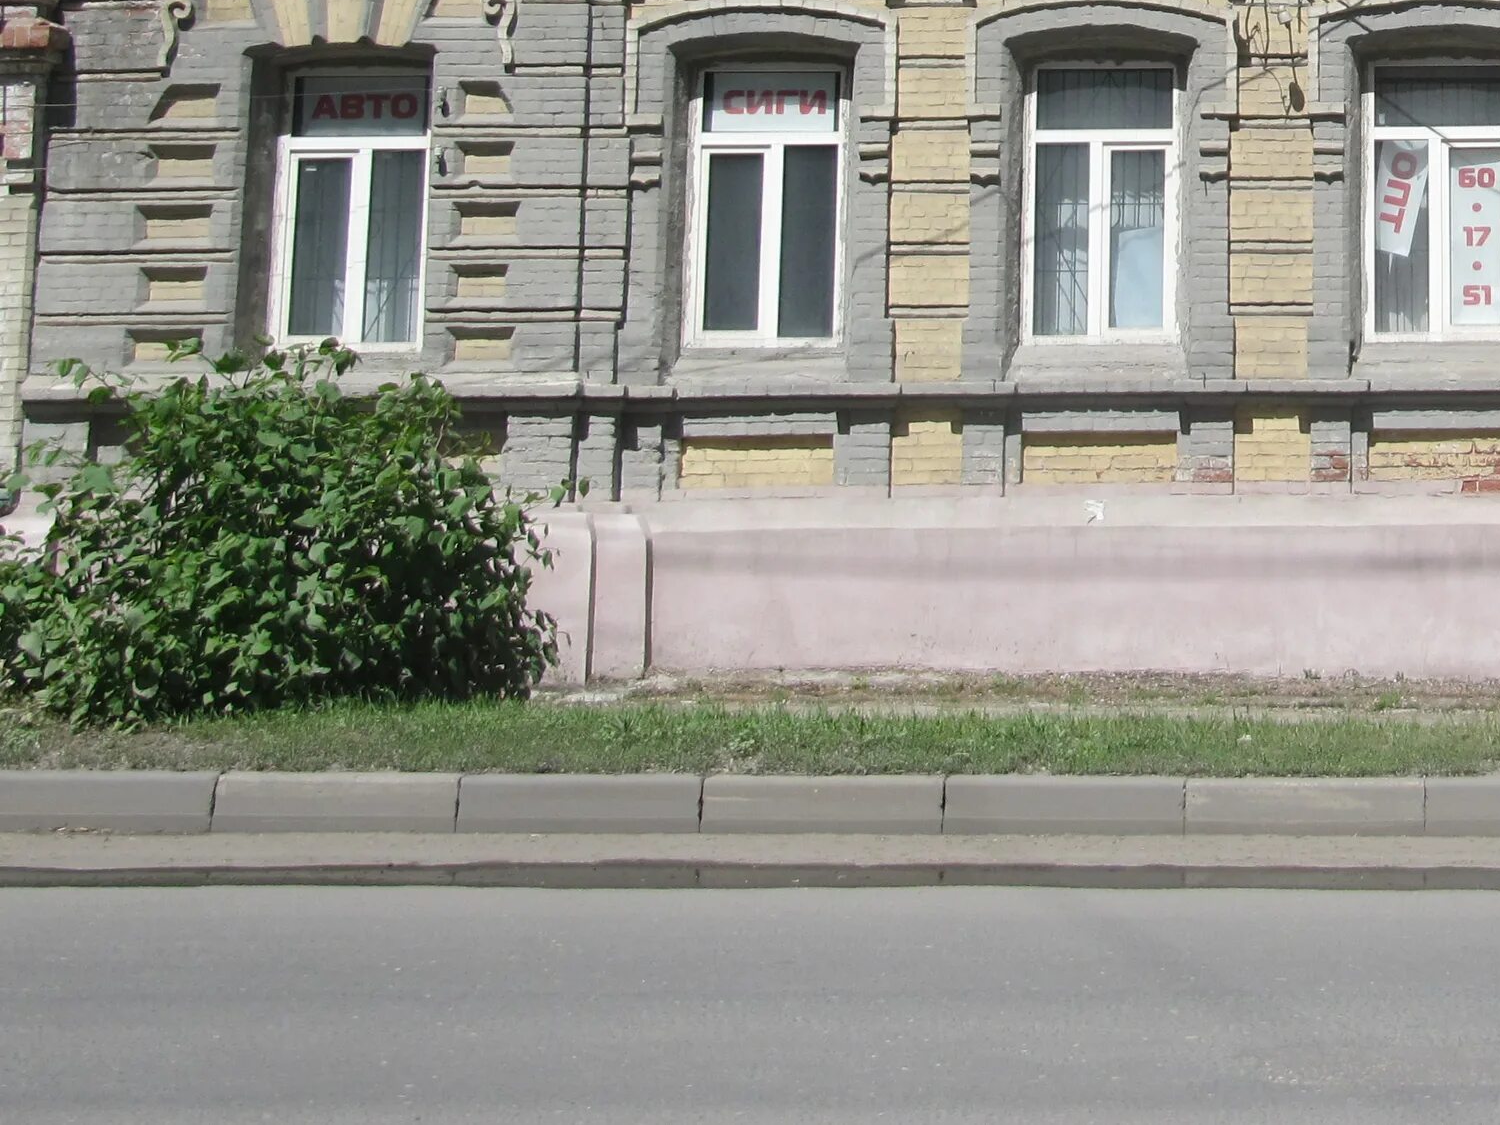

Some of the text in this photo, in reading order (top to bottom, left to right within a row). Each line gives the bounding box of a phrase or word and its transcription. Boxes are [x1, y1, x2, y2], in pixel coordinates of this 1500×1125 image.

[311, 94, 418, 119] АВТО
[723, 89, 826, 115] СИГИ
[1458, 167, 1495, 188] 60
[1378, 151, 1417, 234] ОПТ
[1462, 226, 1491, 247] 17
[1462, 285, 1491, 305] 51
